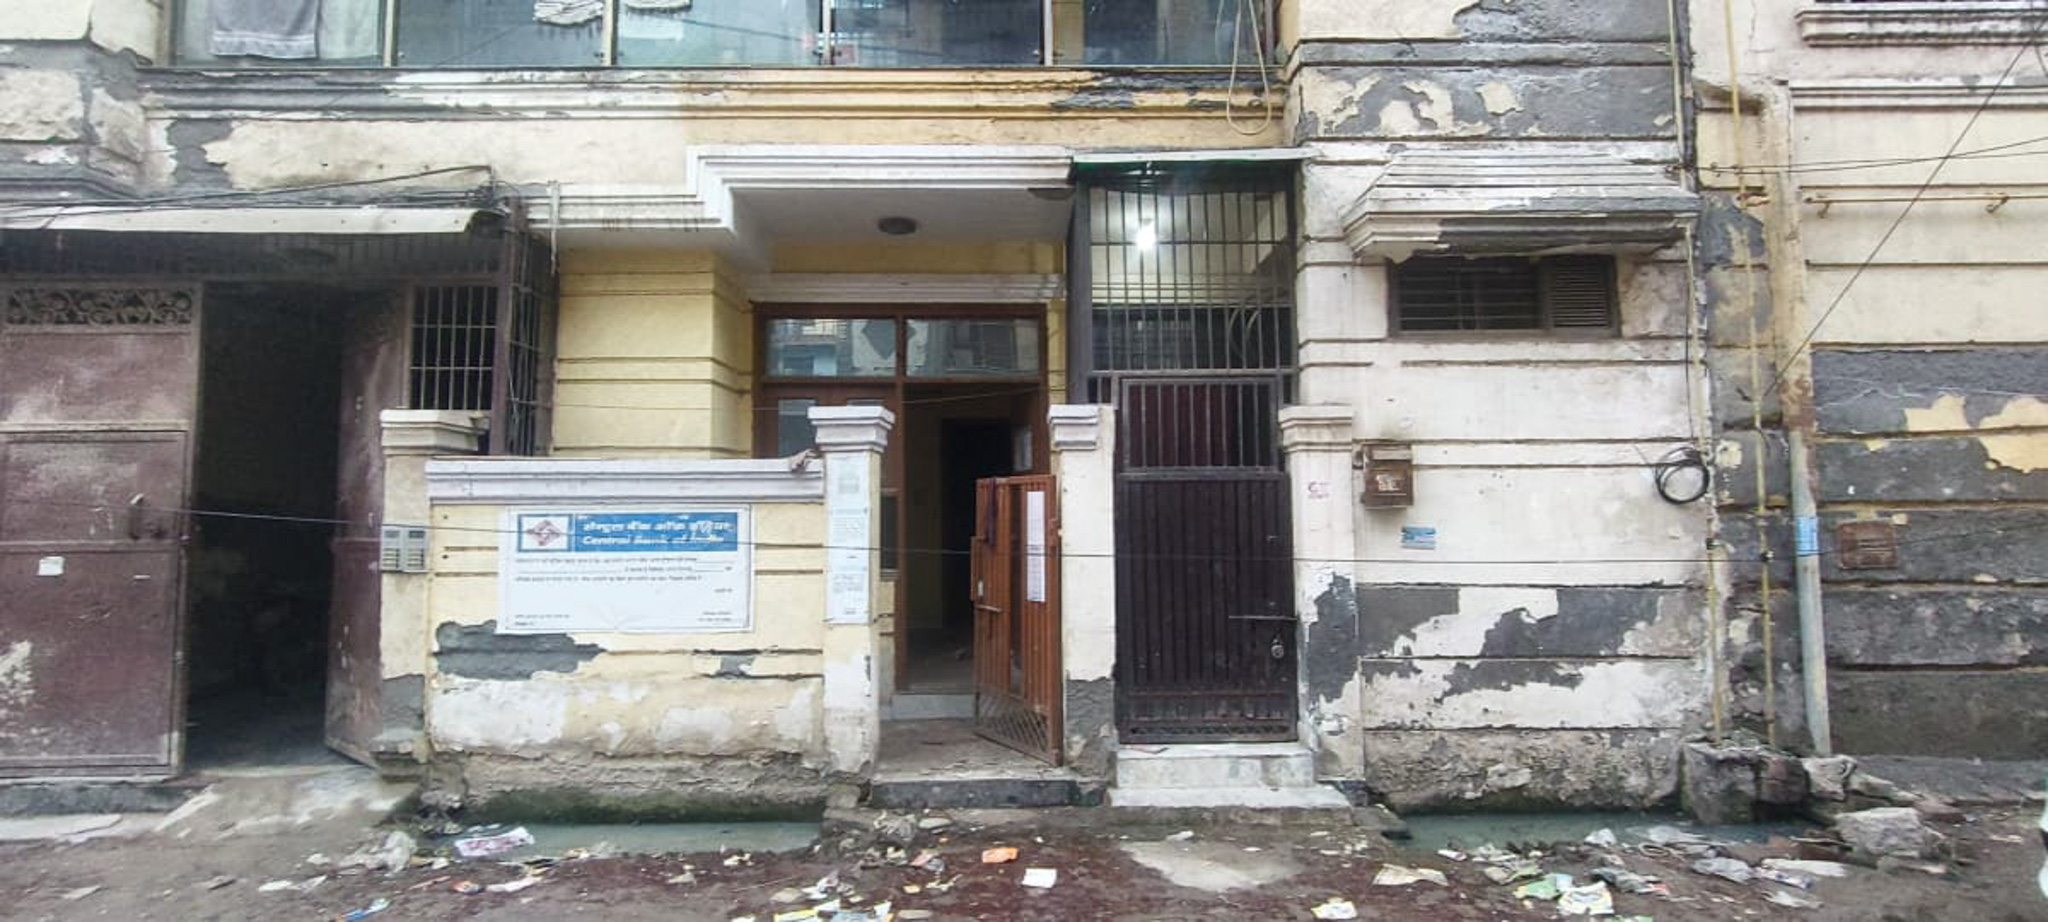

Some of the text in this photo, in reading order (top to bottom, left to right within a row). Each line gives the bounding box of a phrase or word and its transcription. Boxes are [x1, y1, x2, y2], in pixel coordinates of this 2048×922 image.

[583, 534, 630, 545] Central
[634, 534, 668, 544] Bank
[672, 533, 689, 544] of
